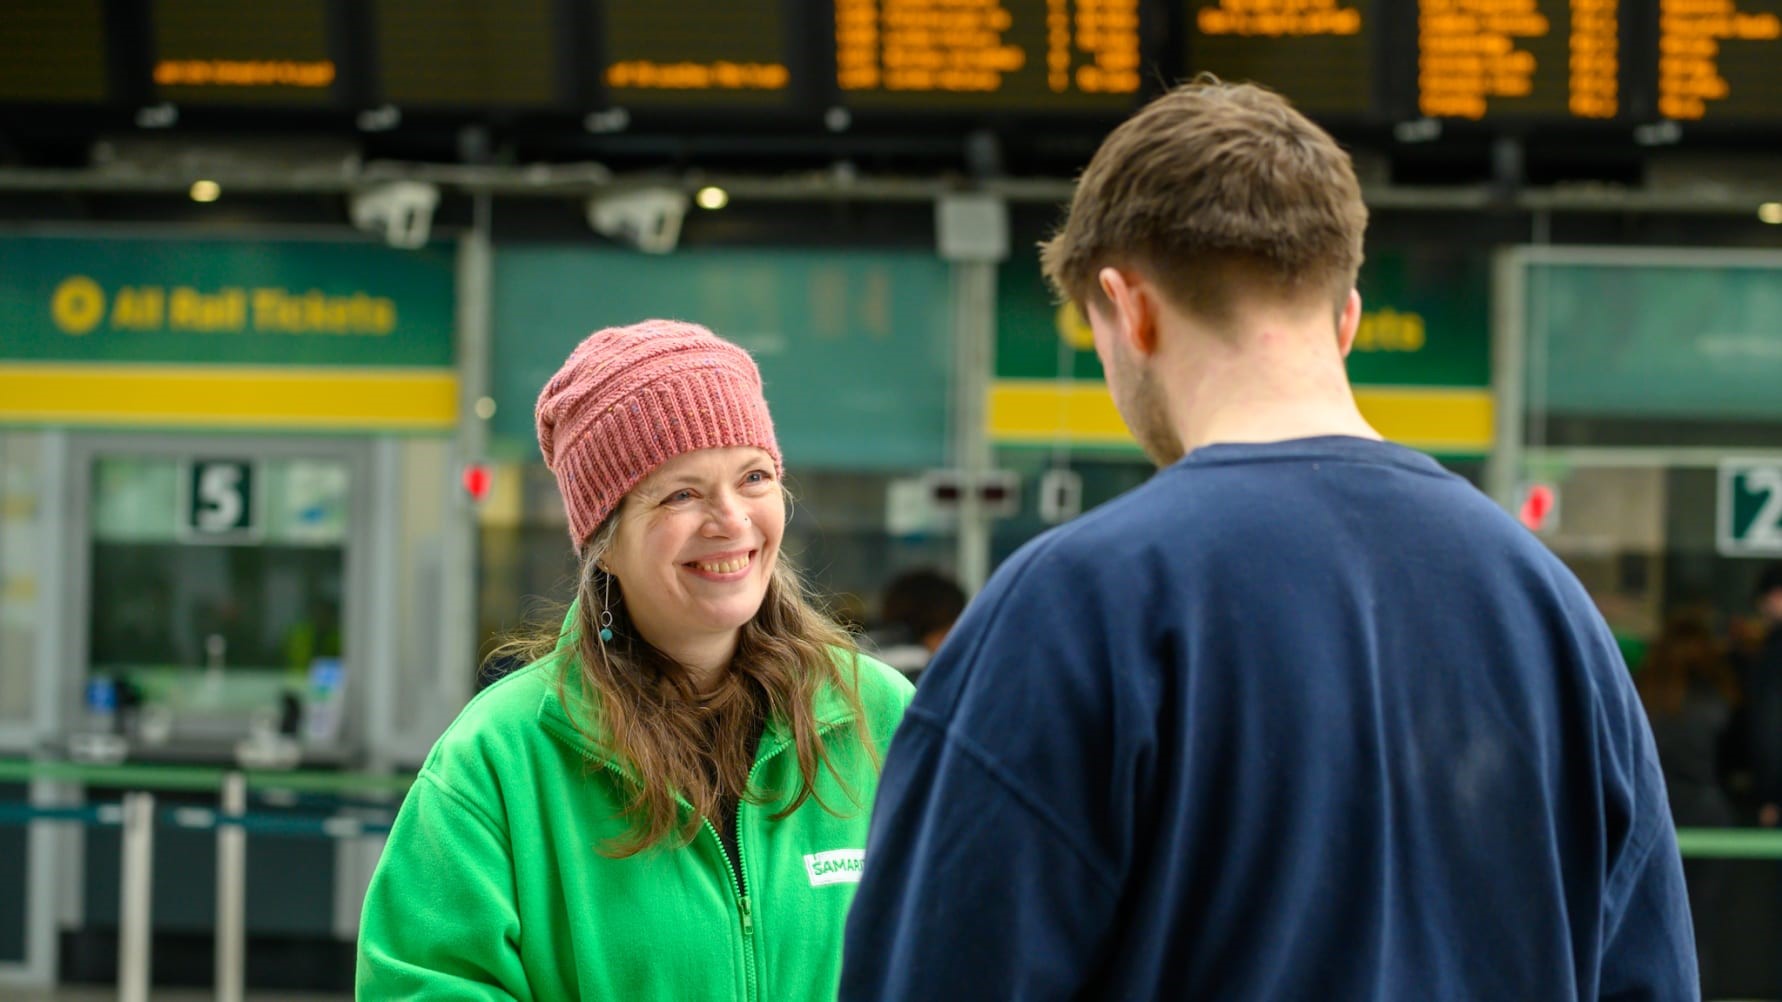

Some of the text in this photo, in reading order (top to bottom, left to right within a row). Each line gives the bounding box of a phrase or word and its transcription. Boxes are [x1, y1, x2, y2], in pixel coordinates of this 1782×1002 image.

[112, 285, 396, 335] All Rail Tickets
[199, 464, 243, 533] 5
[1743, 467, 1782, 547] 2
